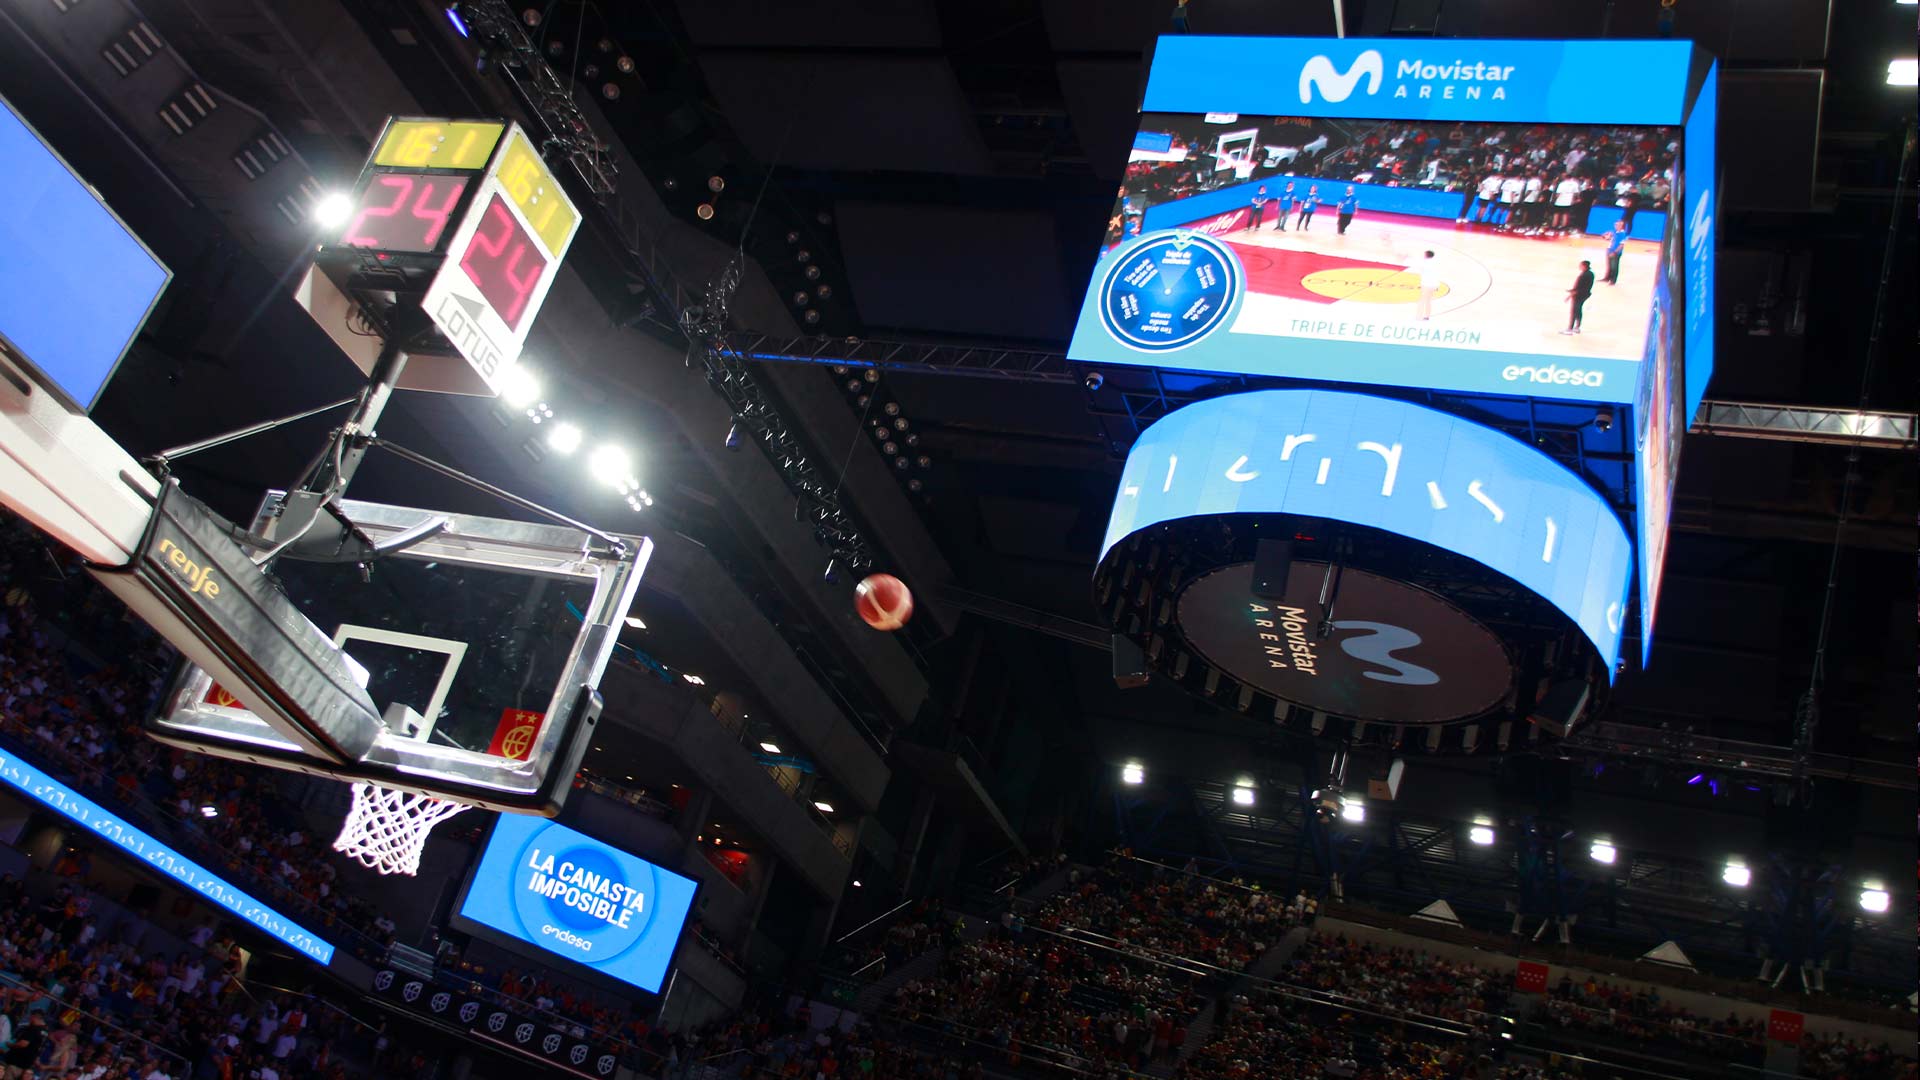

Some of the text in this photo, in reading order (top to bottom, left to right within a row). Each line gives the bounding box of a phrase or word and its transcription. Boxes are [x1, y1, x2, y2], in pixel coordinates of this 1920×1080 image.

[1393, 84, 1506, 100] ARENA
[1397, 59, 1516, 81] Movistar
[344, 177, 464, 246] 24
[460, 203, 541, 321] 24
[436, 297, 500, 378] LOTUS
[1290, 320, 1482, 344] TRIPLE DE CUCHARÓN
[1502, 364, 1604, 387] endesa
[159, 539, 220, 600] renfe
[1249, 603, 1288, 668] ARENA
[1277, 605, 1318, 675] Movistar
[527, 849, 645, 913] LA CANASTA
[527, 872, 634, 929] IMPOSIBLE
[541, 922, 593, 952] endesa
